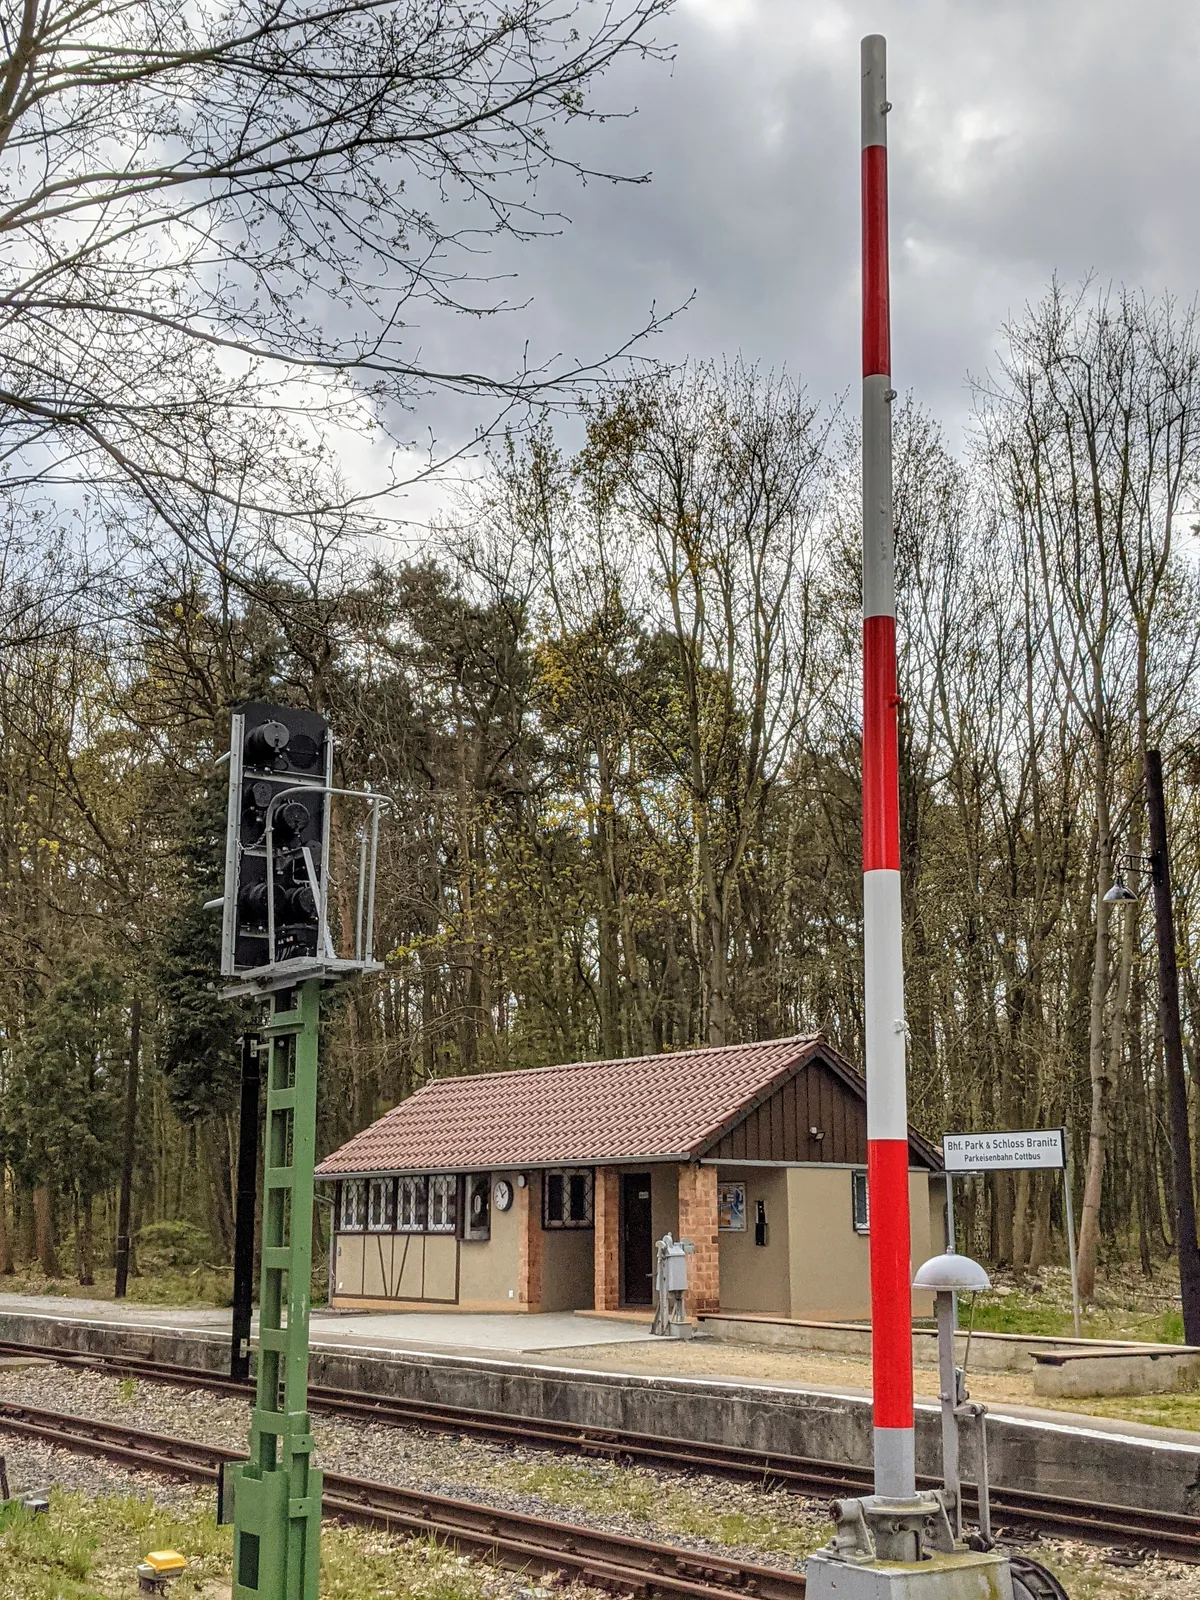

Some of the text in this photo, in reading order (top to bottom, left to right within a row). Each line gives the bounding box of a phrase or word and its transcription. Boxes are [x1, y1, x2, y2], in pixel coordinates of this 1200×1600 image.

[948, 1141, 964, 1150] Bhf.
[965, 1140, 984, 1150] Park
[993, 1139, 1024, 1148] Schloss
[1026, 1137, 1058, 1148] Branitz
[964, 1152, 1041, 1162] Parkeisenbahn Cottbus
